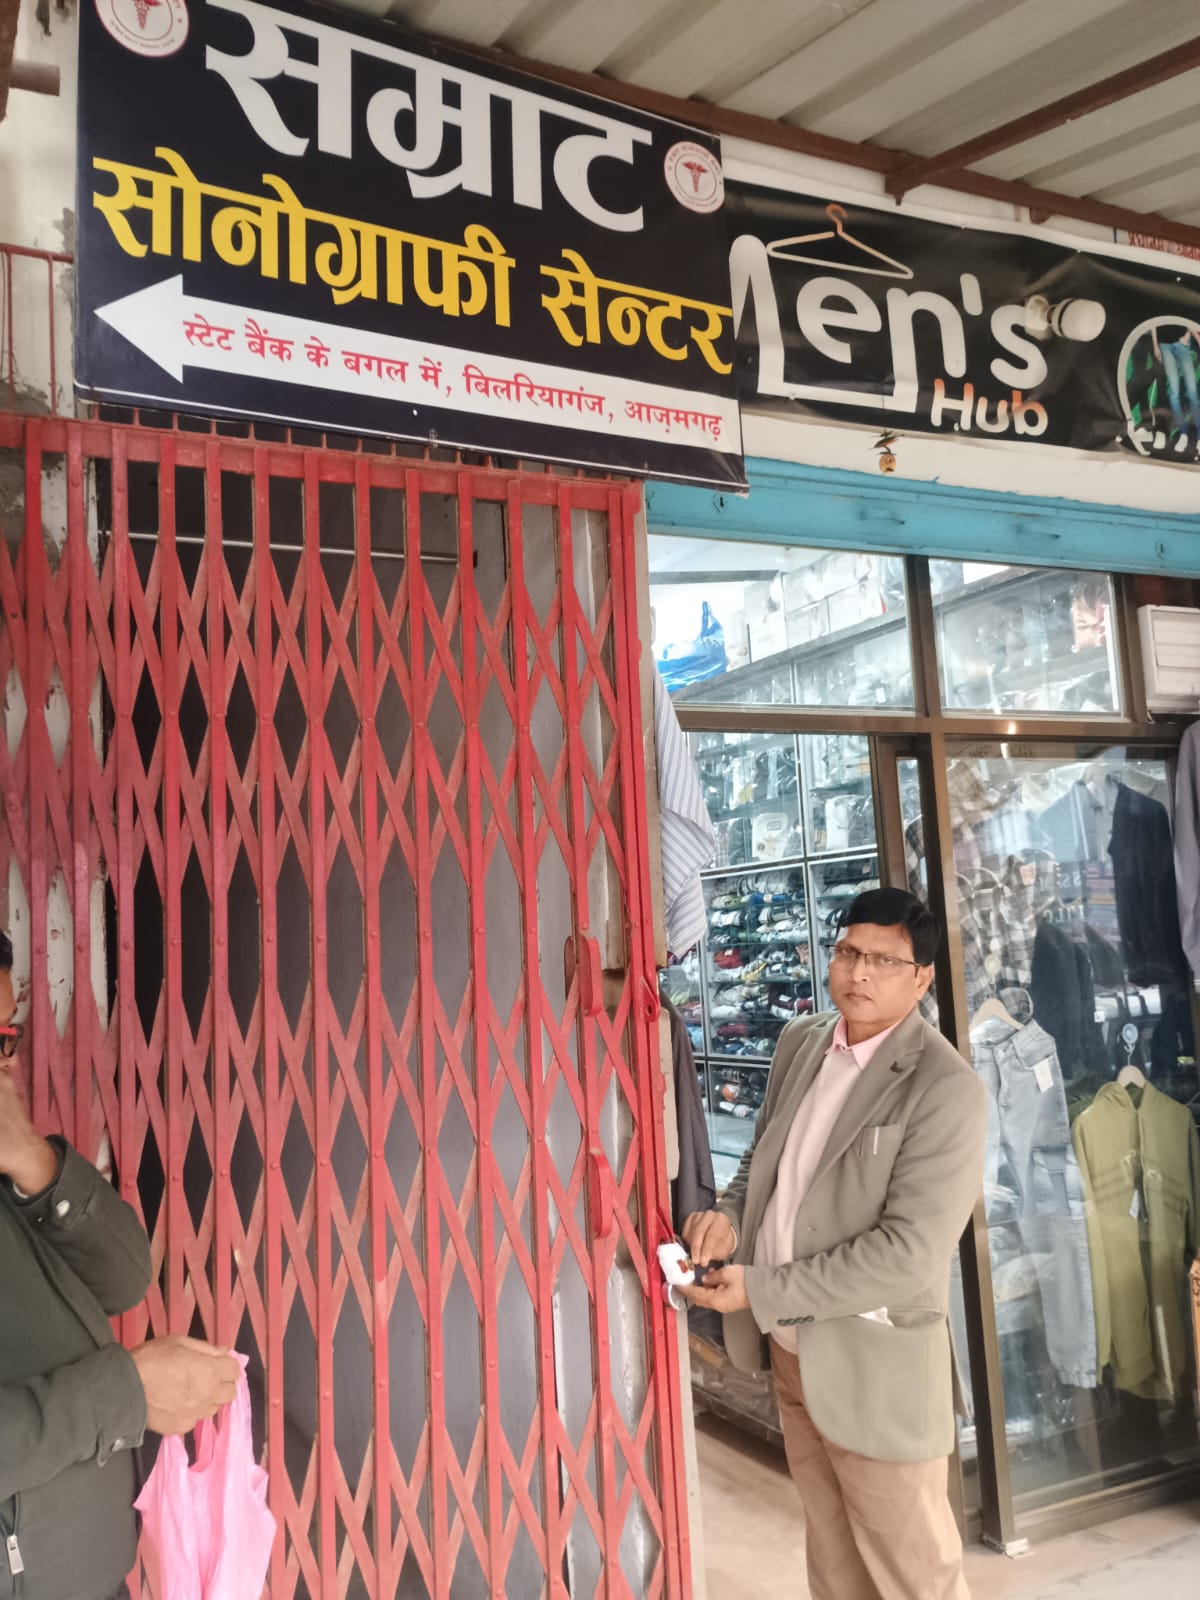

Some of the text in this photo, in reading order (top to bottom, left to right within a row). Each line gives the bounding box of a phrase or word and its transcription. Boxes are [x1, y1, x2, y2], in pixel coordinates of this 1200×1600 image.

[205, 0, 652, 232] सम्राट
[93, 146, 516, 327] सोनोग्राफी
[539, 248, 734, 375] सेन्टर
[183, 313, 236, 352] स्टेट
[244, 318, 295, 362] बैंक
[304, 335, 331, 368] के
[341, 350, 409, 383] बगल
[930, 377, 1049, 436] Hub
